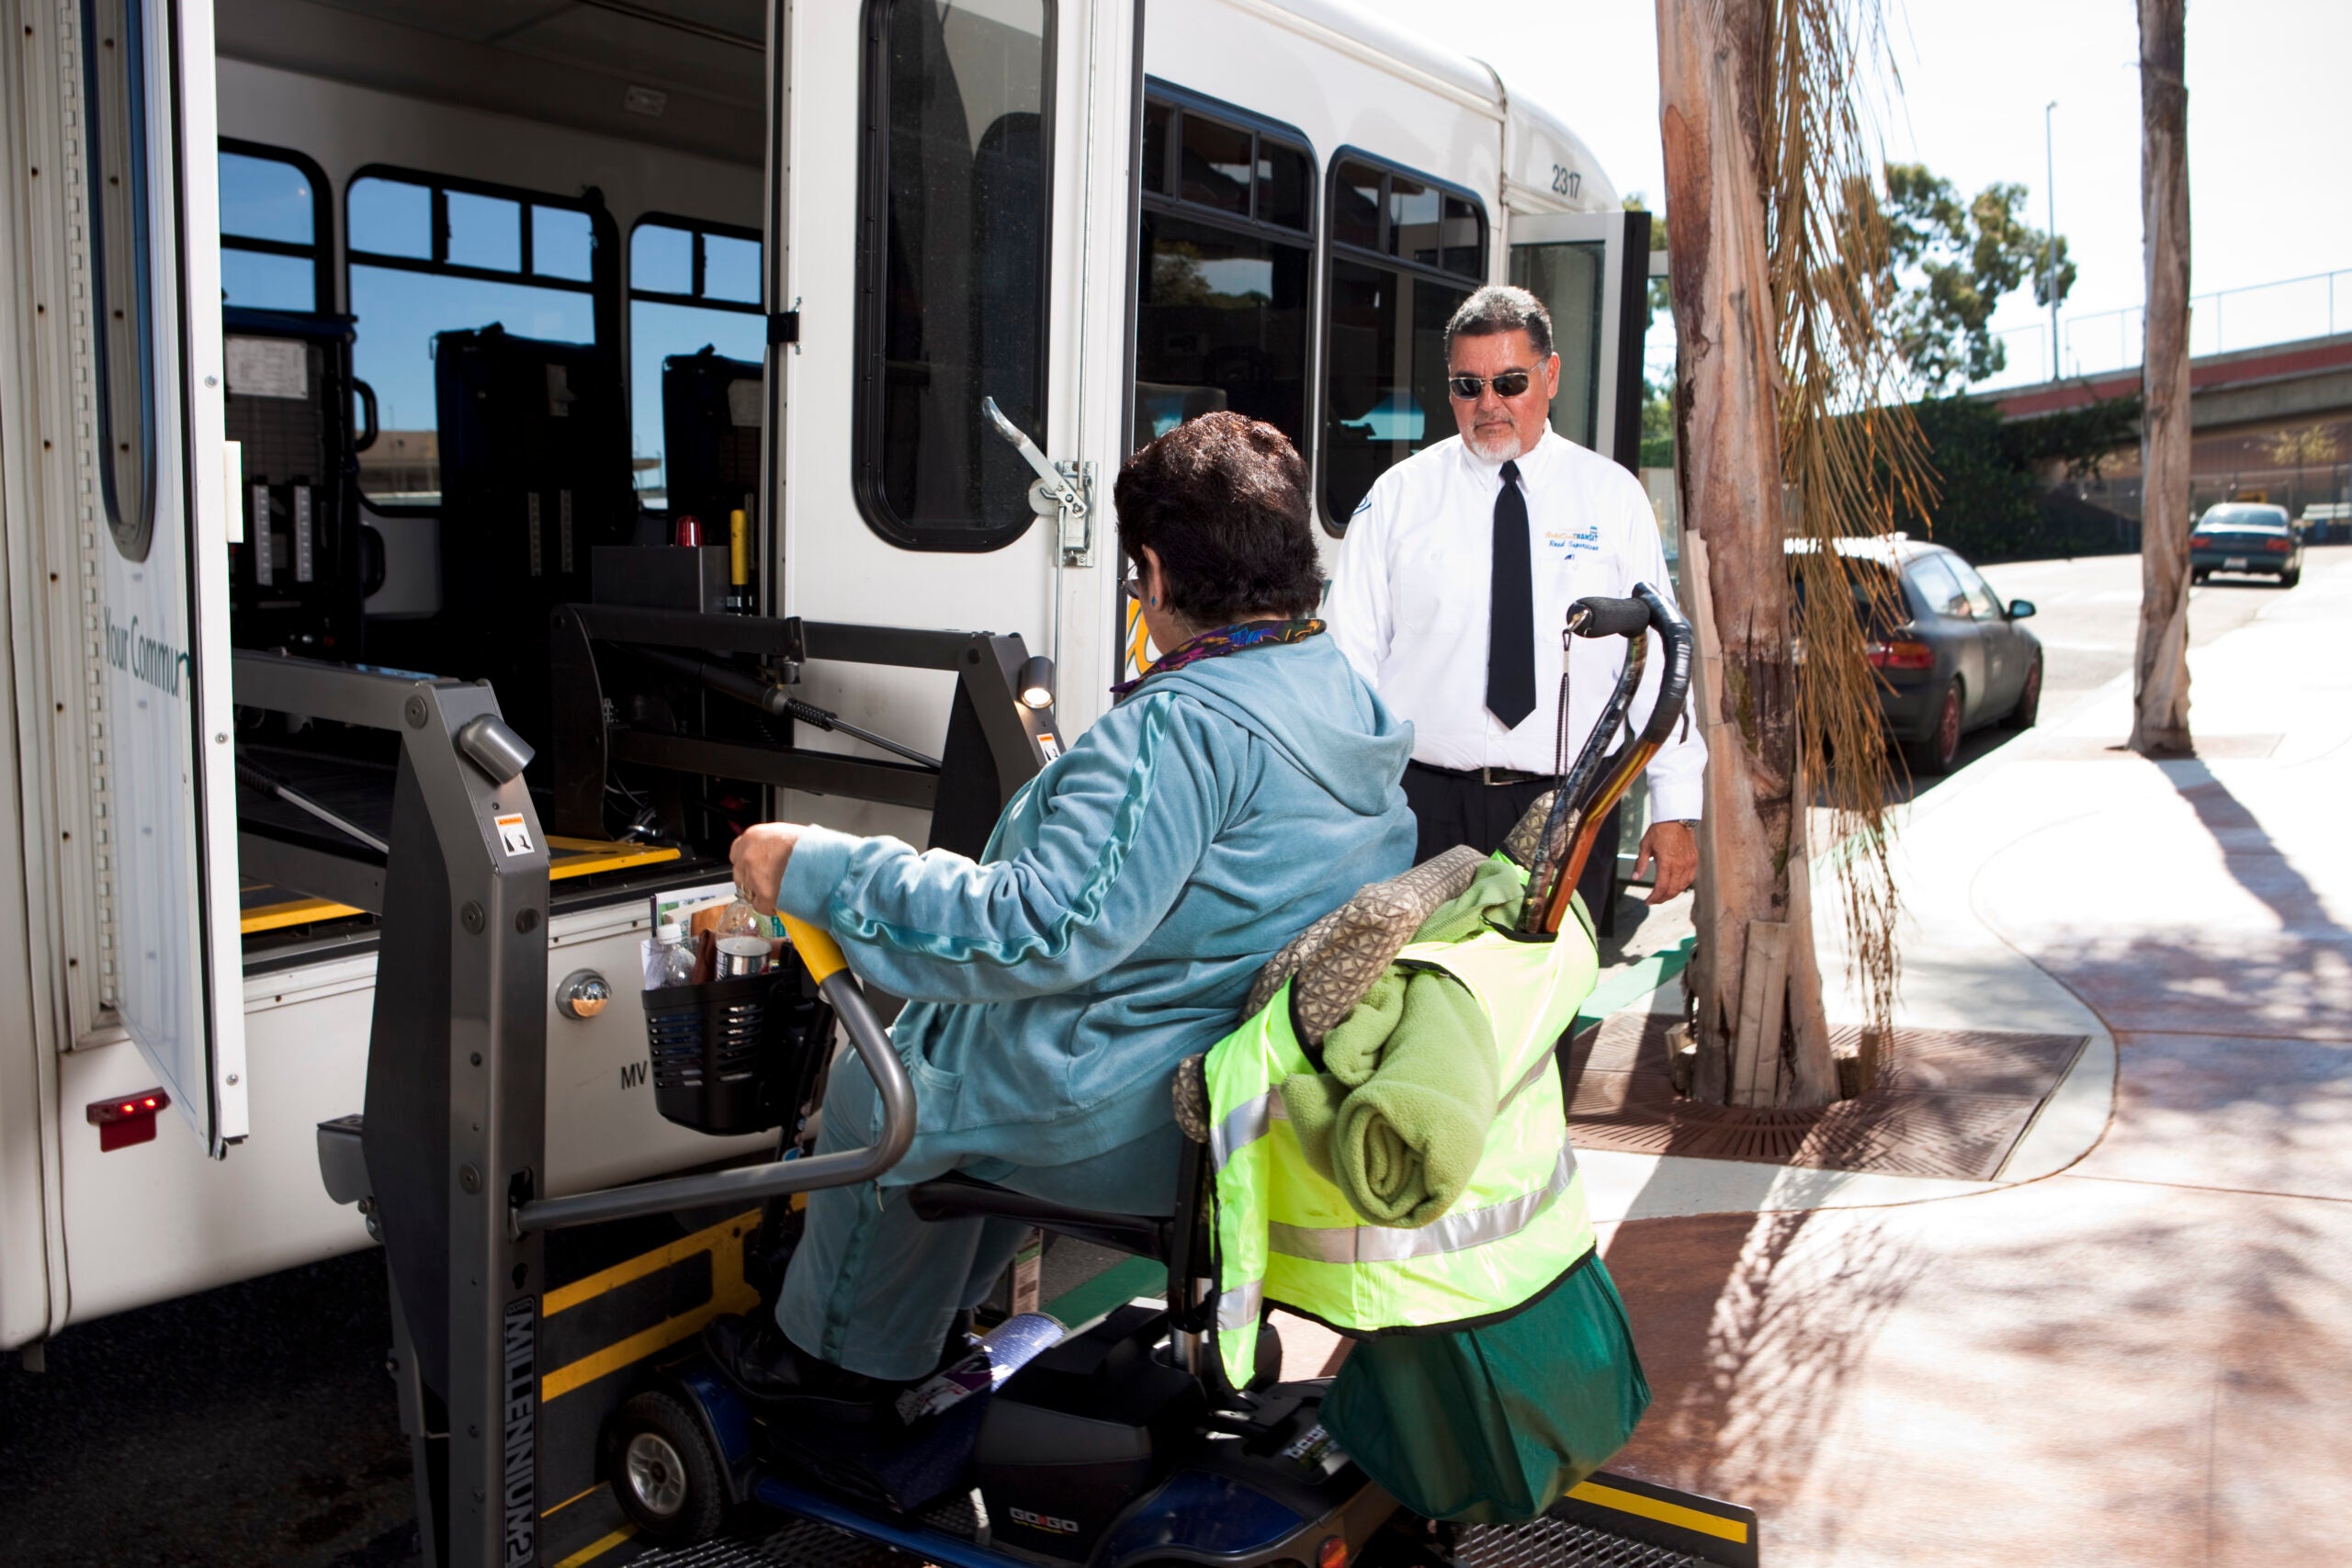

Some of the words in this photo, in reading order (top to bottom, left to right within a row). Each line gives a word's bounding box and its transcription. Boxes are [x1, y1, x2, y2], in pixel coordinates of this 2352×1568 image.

[1552, 164, 1581, 199] 2317
[104, 606, 128, 671] Your
[621, 1060, 648, 1089] MV
